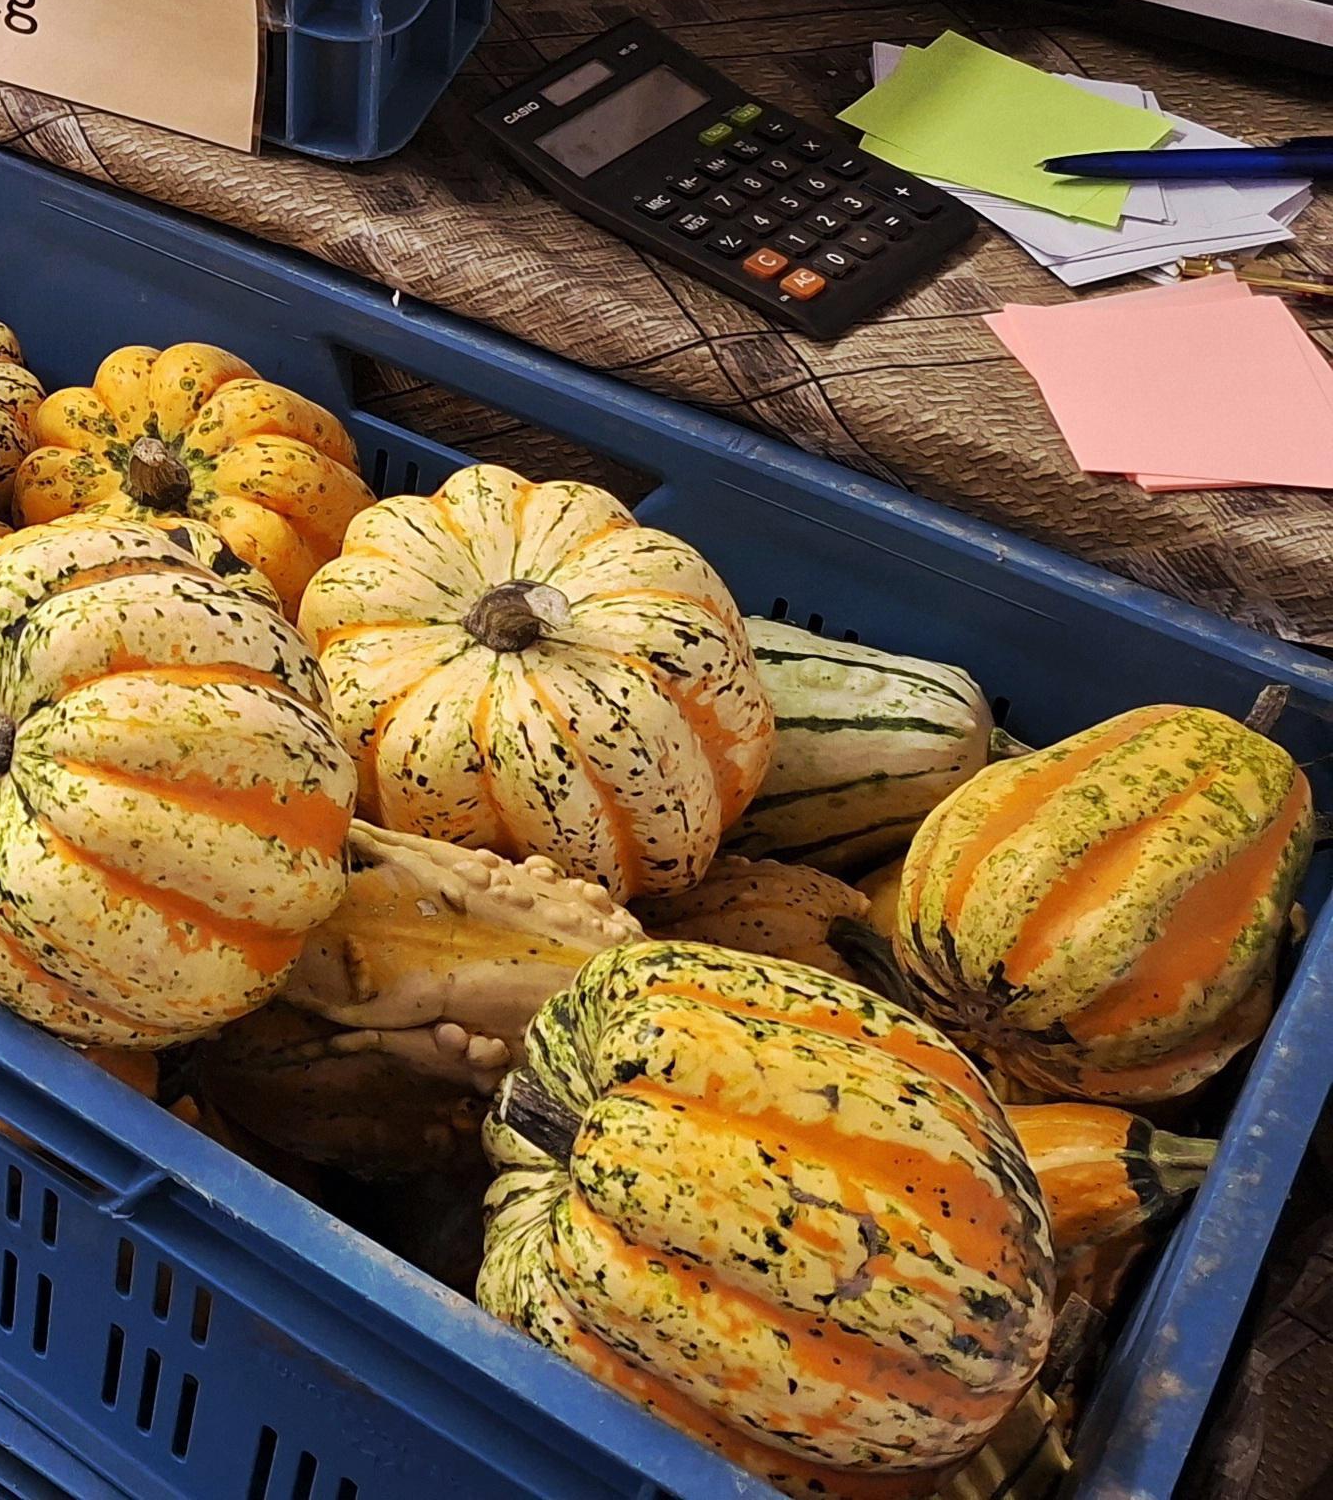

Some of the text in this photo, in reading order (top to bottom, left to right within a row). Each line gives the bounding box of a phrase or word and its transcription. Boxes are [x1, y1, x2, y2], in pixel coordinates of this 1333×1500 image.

[503, 101, 541, 125] CASIO
[706, 157, 729, 173] M+
[770, 159, 789, 171] 9
[743, 177, 763, 190] 8
[808, 177, 827, 190] 6
[644, 194, 672, 211] MRC
[713, 193, 733, 208] 7
[779, 195, 801, 209] 5
[843, 196, 863, 210] 3
[752, 213, 771, 227] 4
[815, 214, 837, 228] 2
[788, 234, 807, 245] 1
[757, 254, 778, 268] C
[825, 252, 846, 266] 0
[792, 271, 817, 289] AC
